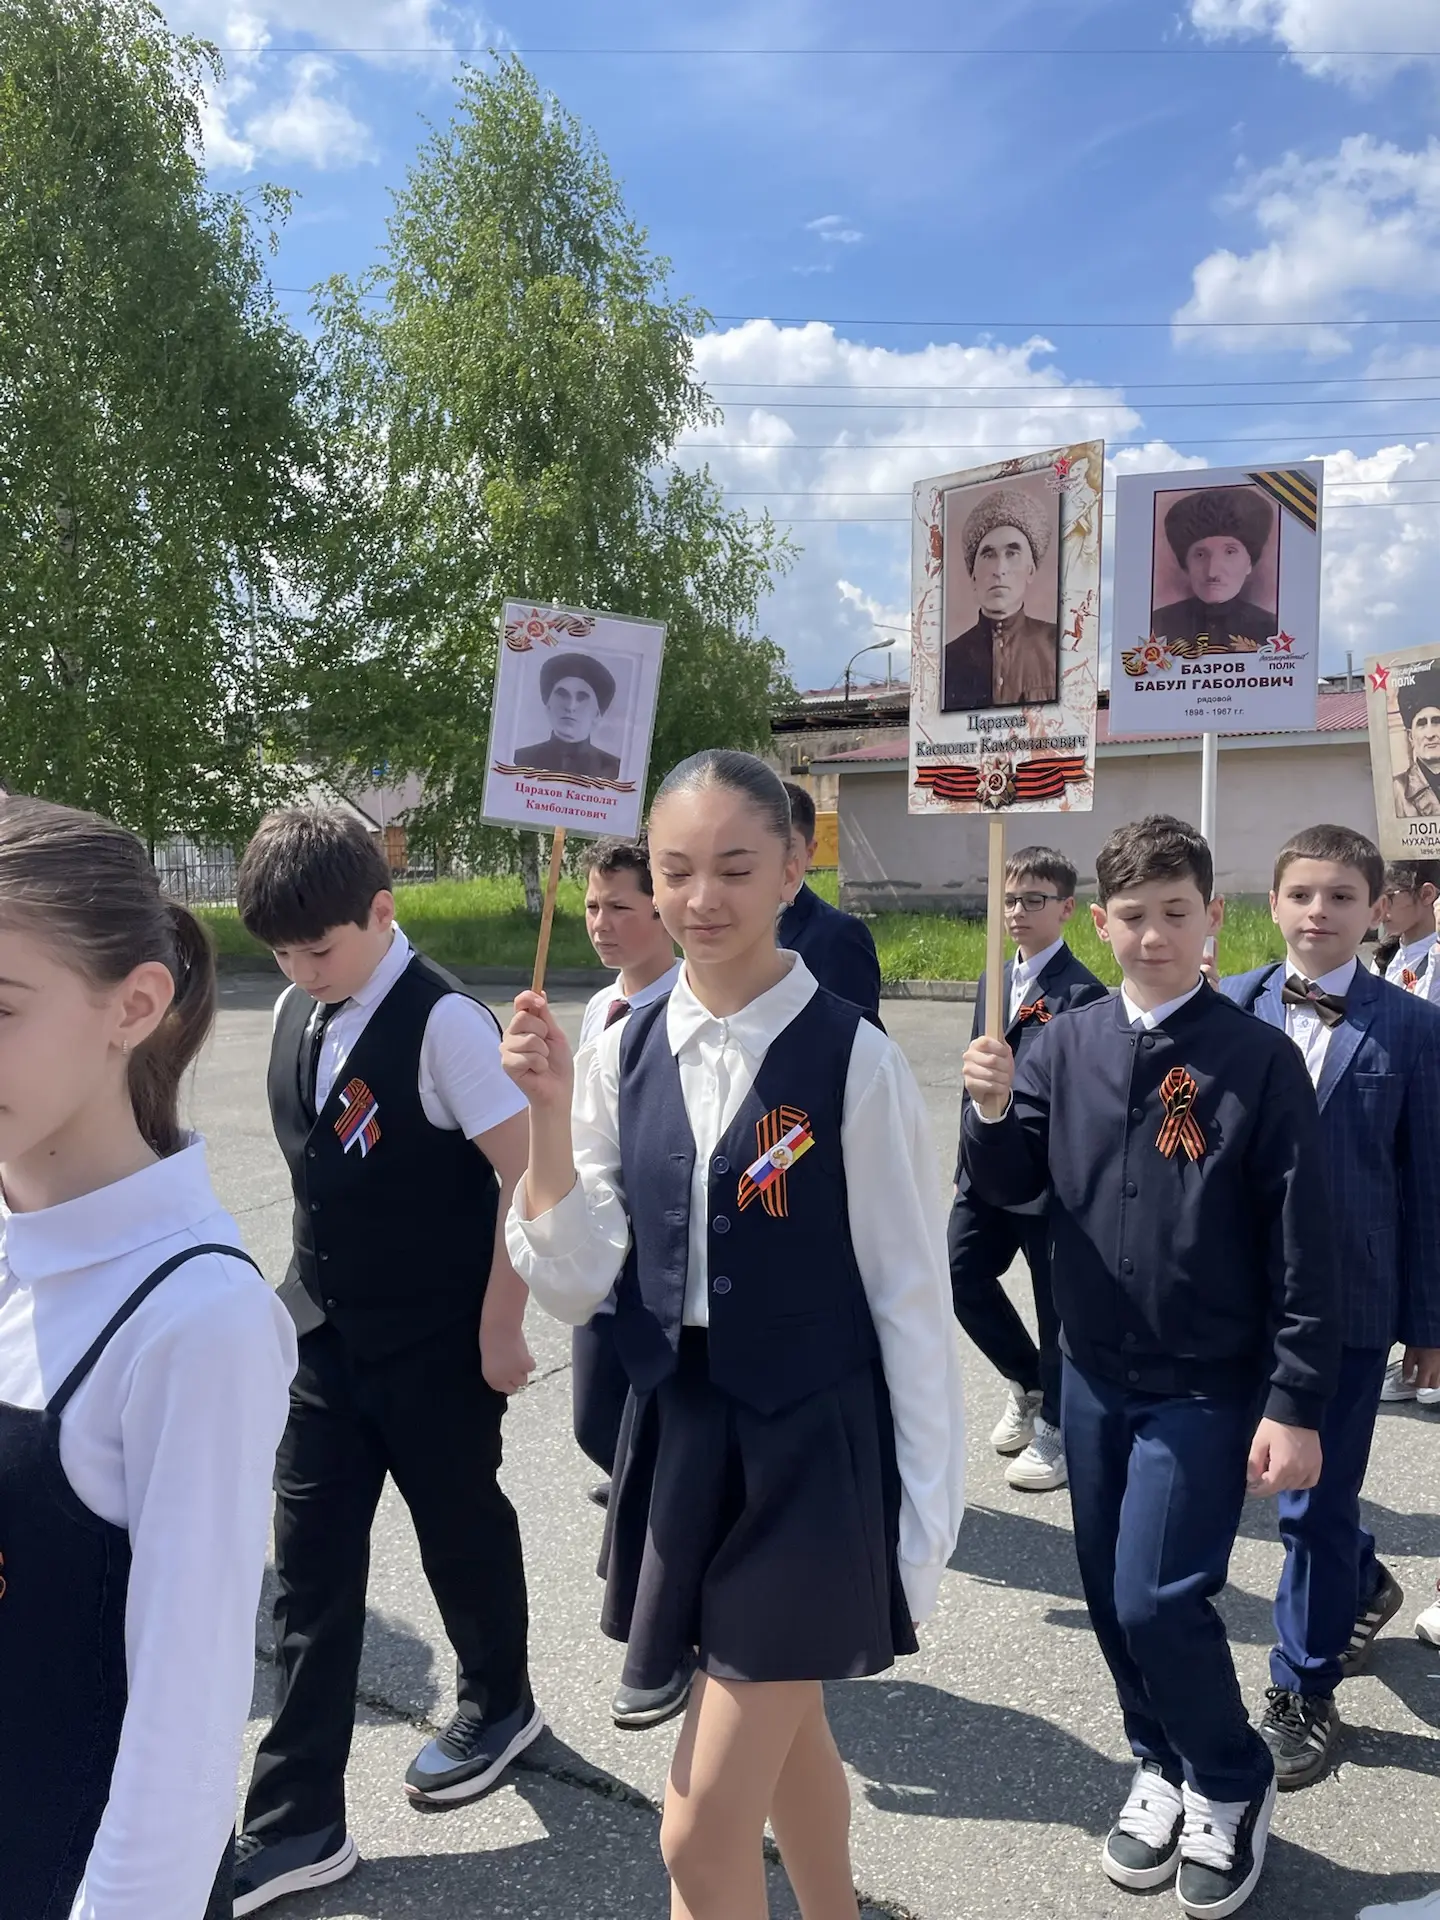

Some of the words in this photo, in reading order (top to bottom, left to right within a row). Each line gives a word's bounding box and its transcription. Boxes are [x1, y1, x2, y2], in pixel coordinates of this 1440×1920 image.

[1181, 662, 1246, 675] БАЗРОВ
[1134, 680, 1186, 692] БАБУЛ
[1192, 676, 1294, 690] ГАБОЛОВИЧ
[1196, 695, 1232, 705] рядовой
[967, 714, 1027, 733] Царахов
[916, 740, 977, 757] Касполат
[980, 734, 1088, 754] Камболатович
[515, 781, 563, 798] Царахов
[566, 789, 618, 806] Касполат
[526, 799, 607, 820] Камболатович
[1409, 822, 1440, 836] ЛОЛ
